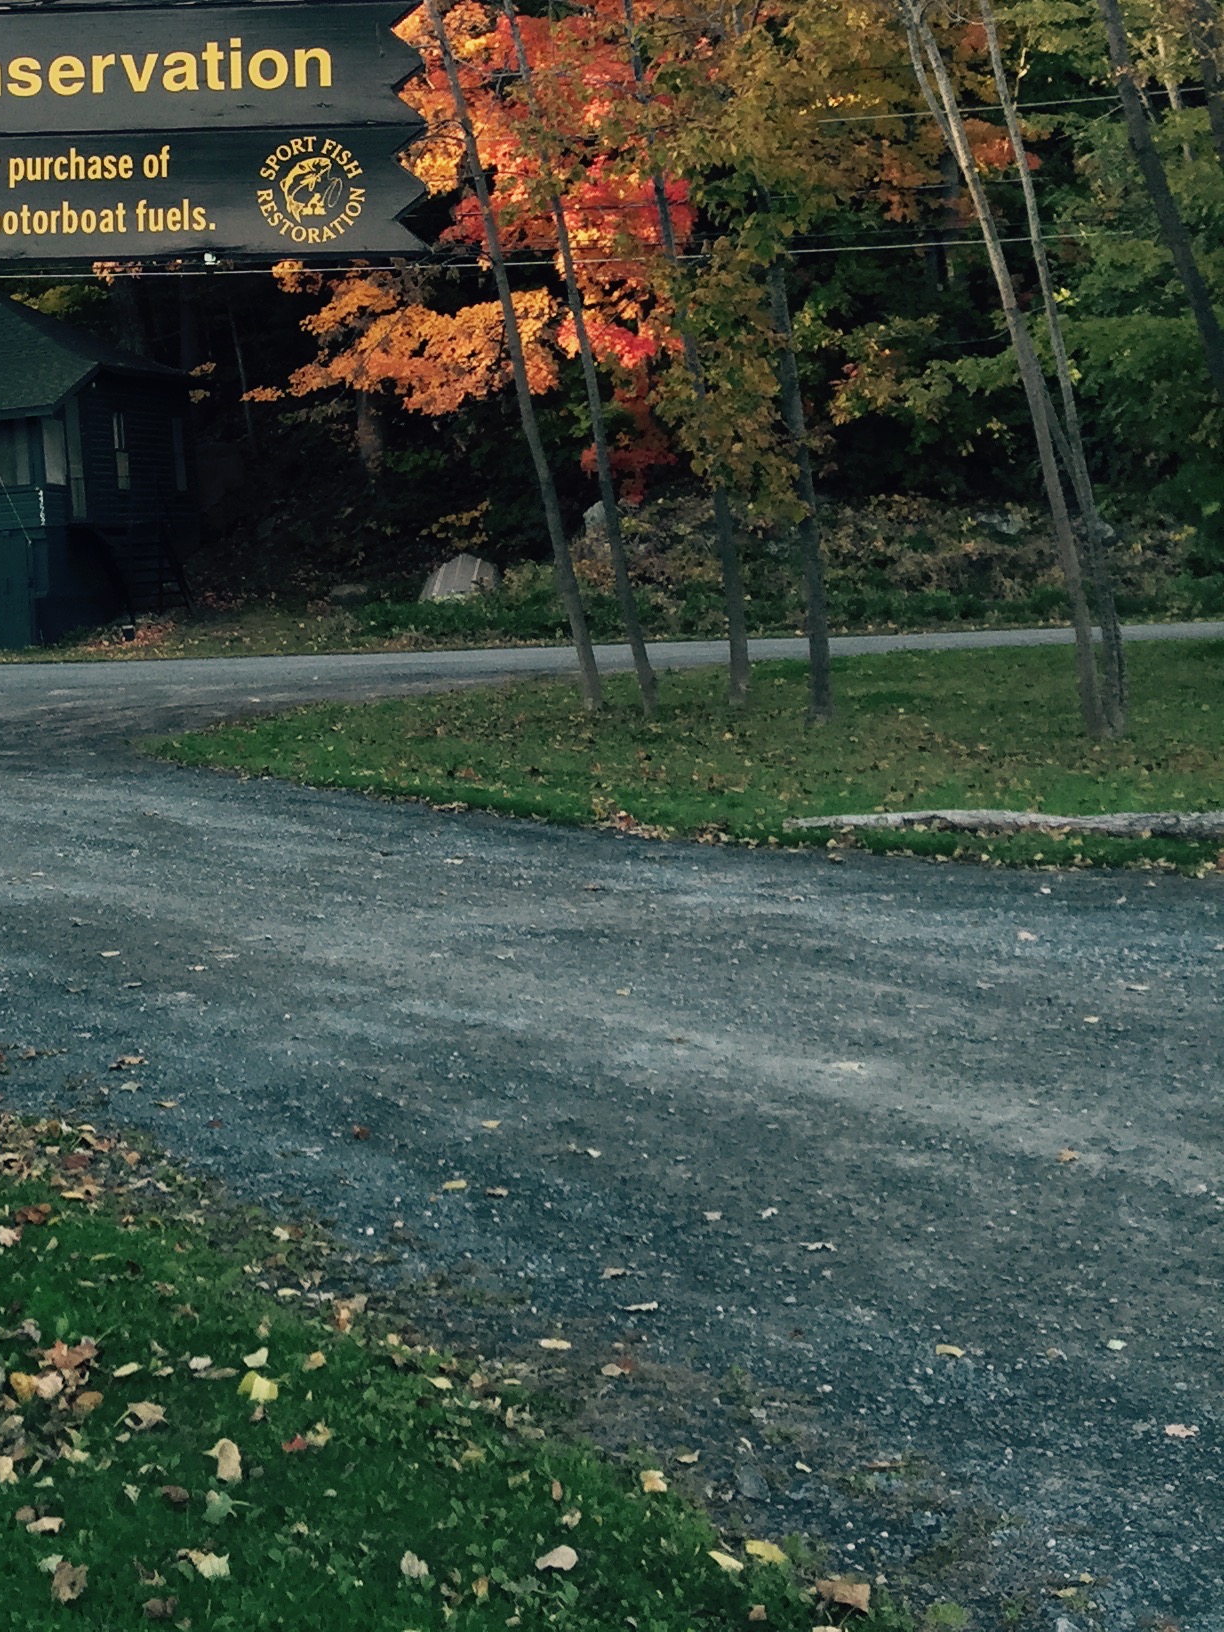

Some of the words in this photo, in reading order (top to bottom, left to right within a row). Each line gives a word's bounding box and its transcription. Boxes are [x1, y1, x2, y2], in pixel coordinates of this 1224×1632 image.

[8, 148, 133, 188] purchase
[143, 145, 170, 179] of
[259, 135, 317, 181] SPORT
[321, 138, 363, 179] FISH
[135, 199, 216, 233] fuels.
[257, 187, 366, 244] RESTORATION
